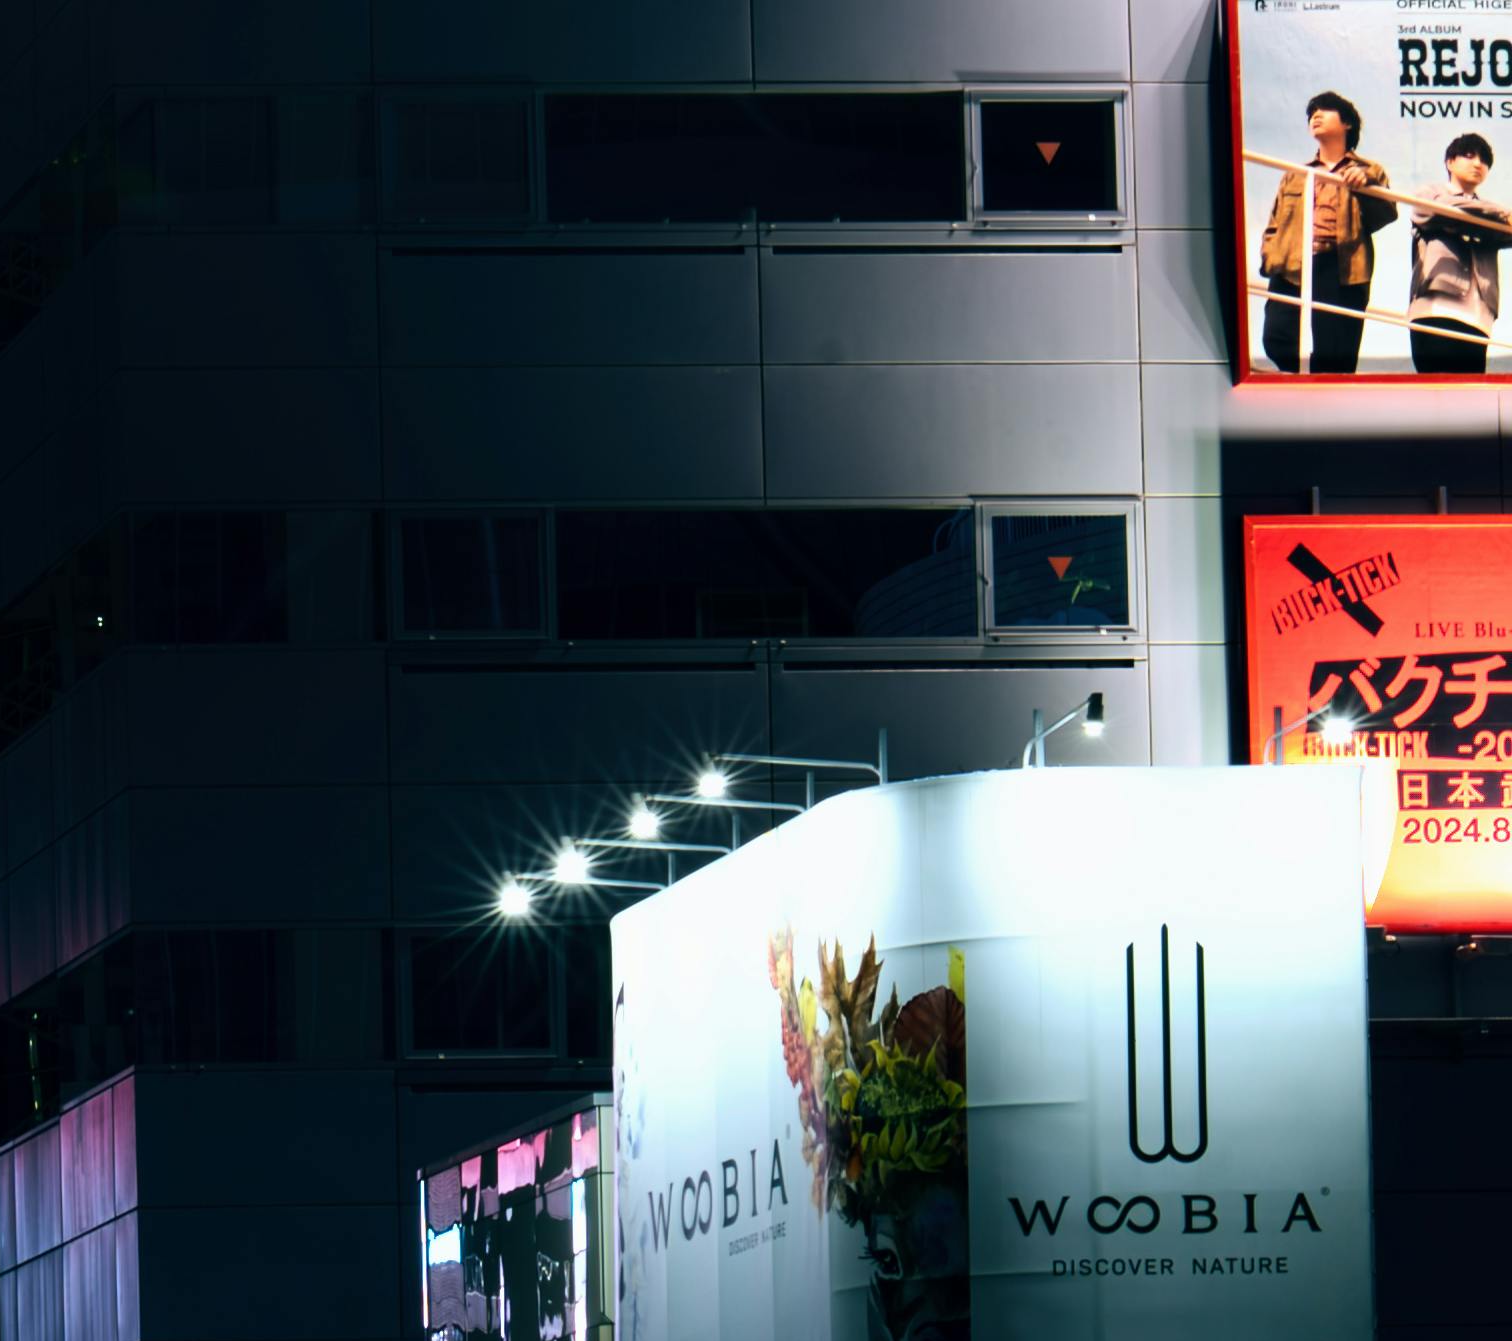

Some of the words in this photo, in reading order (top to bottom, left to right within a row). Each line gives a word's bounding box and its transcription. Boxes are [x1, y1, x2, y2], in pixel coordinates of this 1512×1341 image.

[1397, 0, 1465, 9] OFFICIAL
[1398, 25, 1416, 34] 3rd
[1421, 25, 1462, 34] ALBUM
[1398, 38, 1512, 87] REJO
[1400, 101, 1462, 118] NOW
[1470, 101, 1493, 118] IN
[1271, 552, 1401, 635] BUCK-TICK
[1415, 622, 1464, 638] LIVE
[1309, 655, 1512, 729] バクチ
[1403, 817, 1512, 844] 2024.8
[1052, 1259, 1174, 1276] DISCOVER
[1192, 1256, 1289, 1274] NATURE
